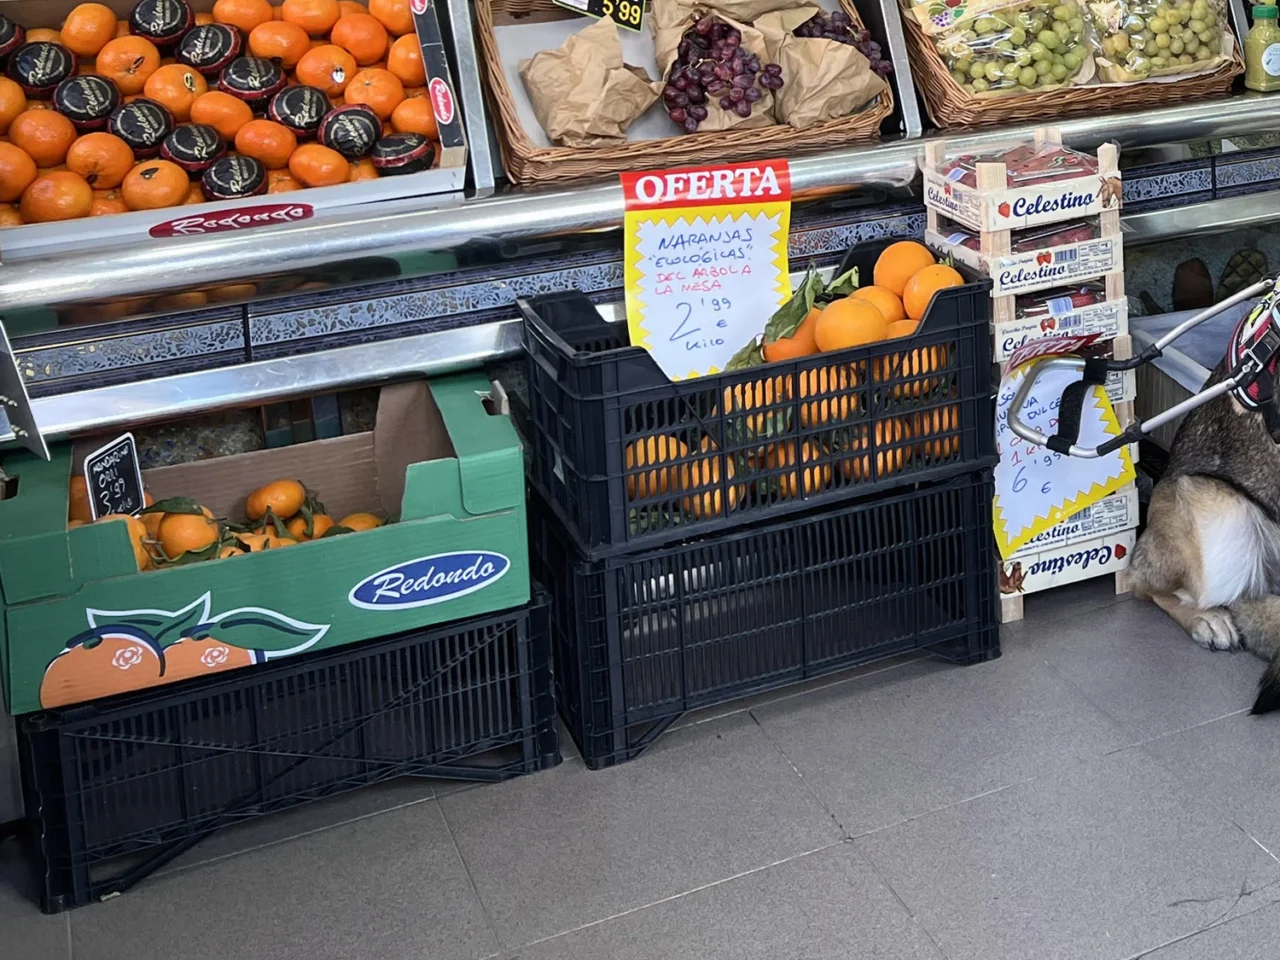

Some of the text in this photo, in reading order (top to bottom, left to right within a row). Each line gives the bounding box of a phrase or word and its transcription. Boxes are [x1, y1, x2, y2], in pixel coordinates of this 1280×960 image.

[635, 166, 782, 203] OFERTA
[927, 186, 959, 212] Celestino
[1012, 191, 1095, 219] Celestino
[658, 228, 753, 250] NARANJAS
[656, 272, 686, 284] DEL
[1000, 264, 1066, 286] Celestino
[655, 280, 722, 296] LA MESA
[716, 319, 728, 329] €
[1029, 543, 1112, 576] Celestino
[372, 555, 496, 603] Redondo
